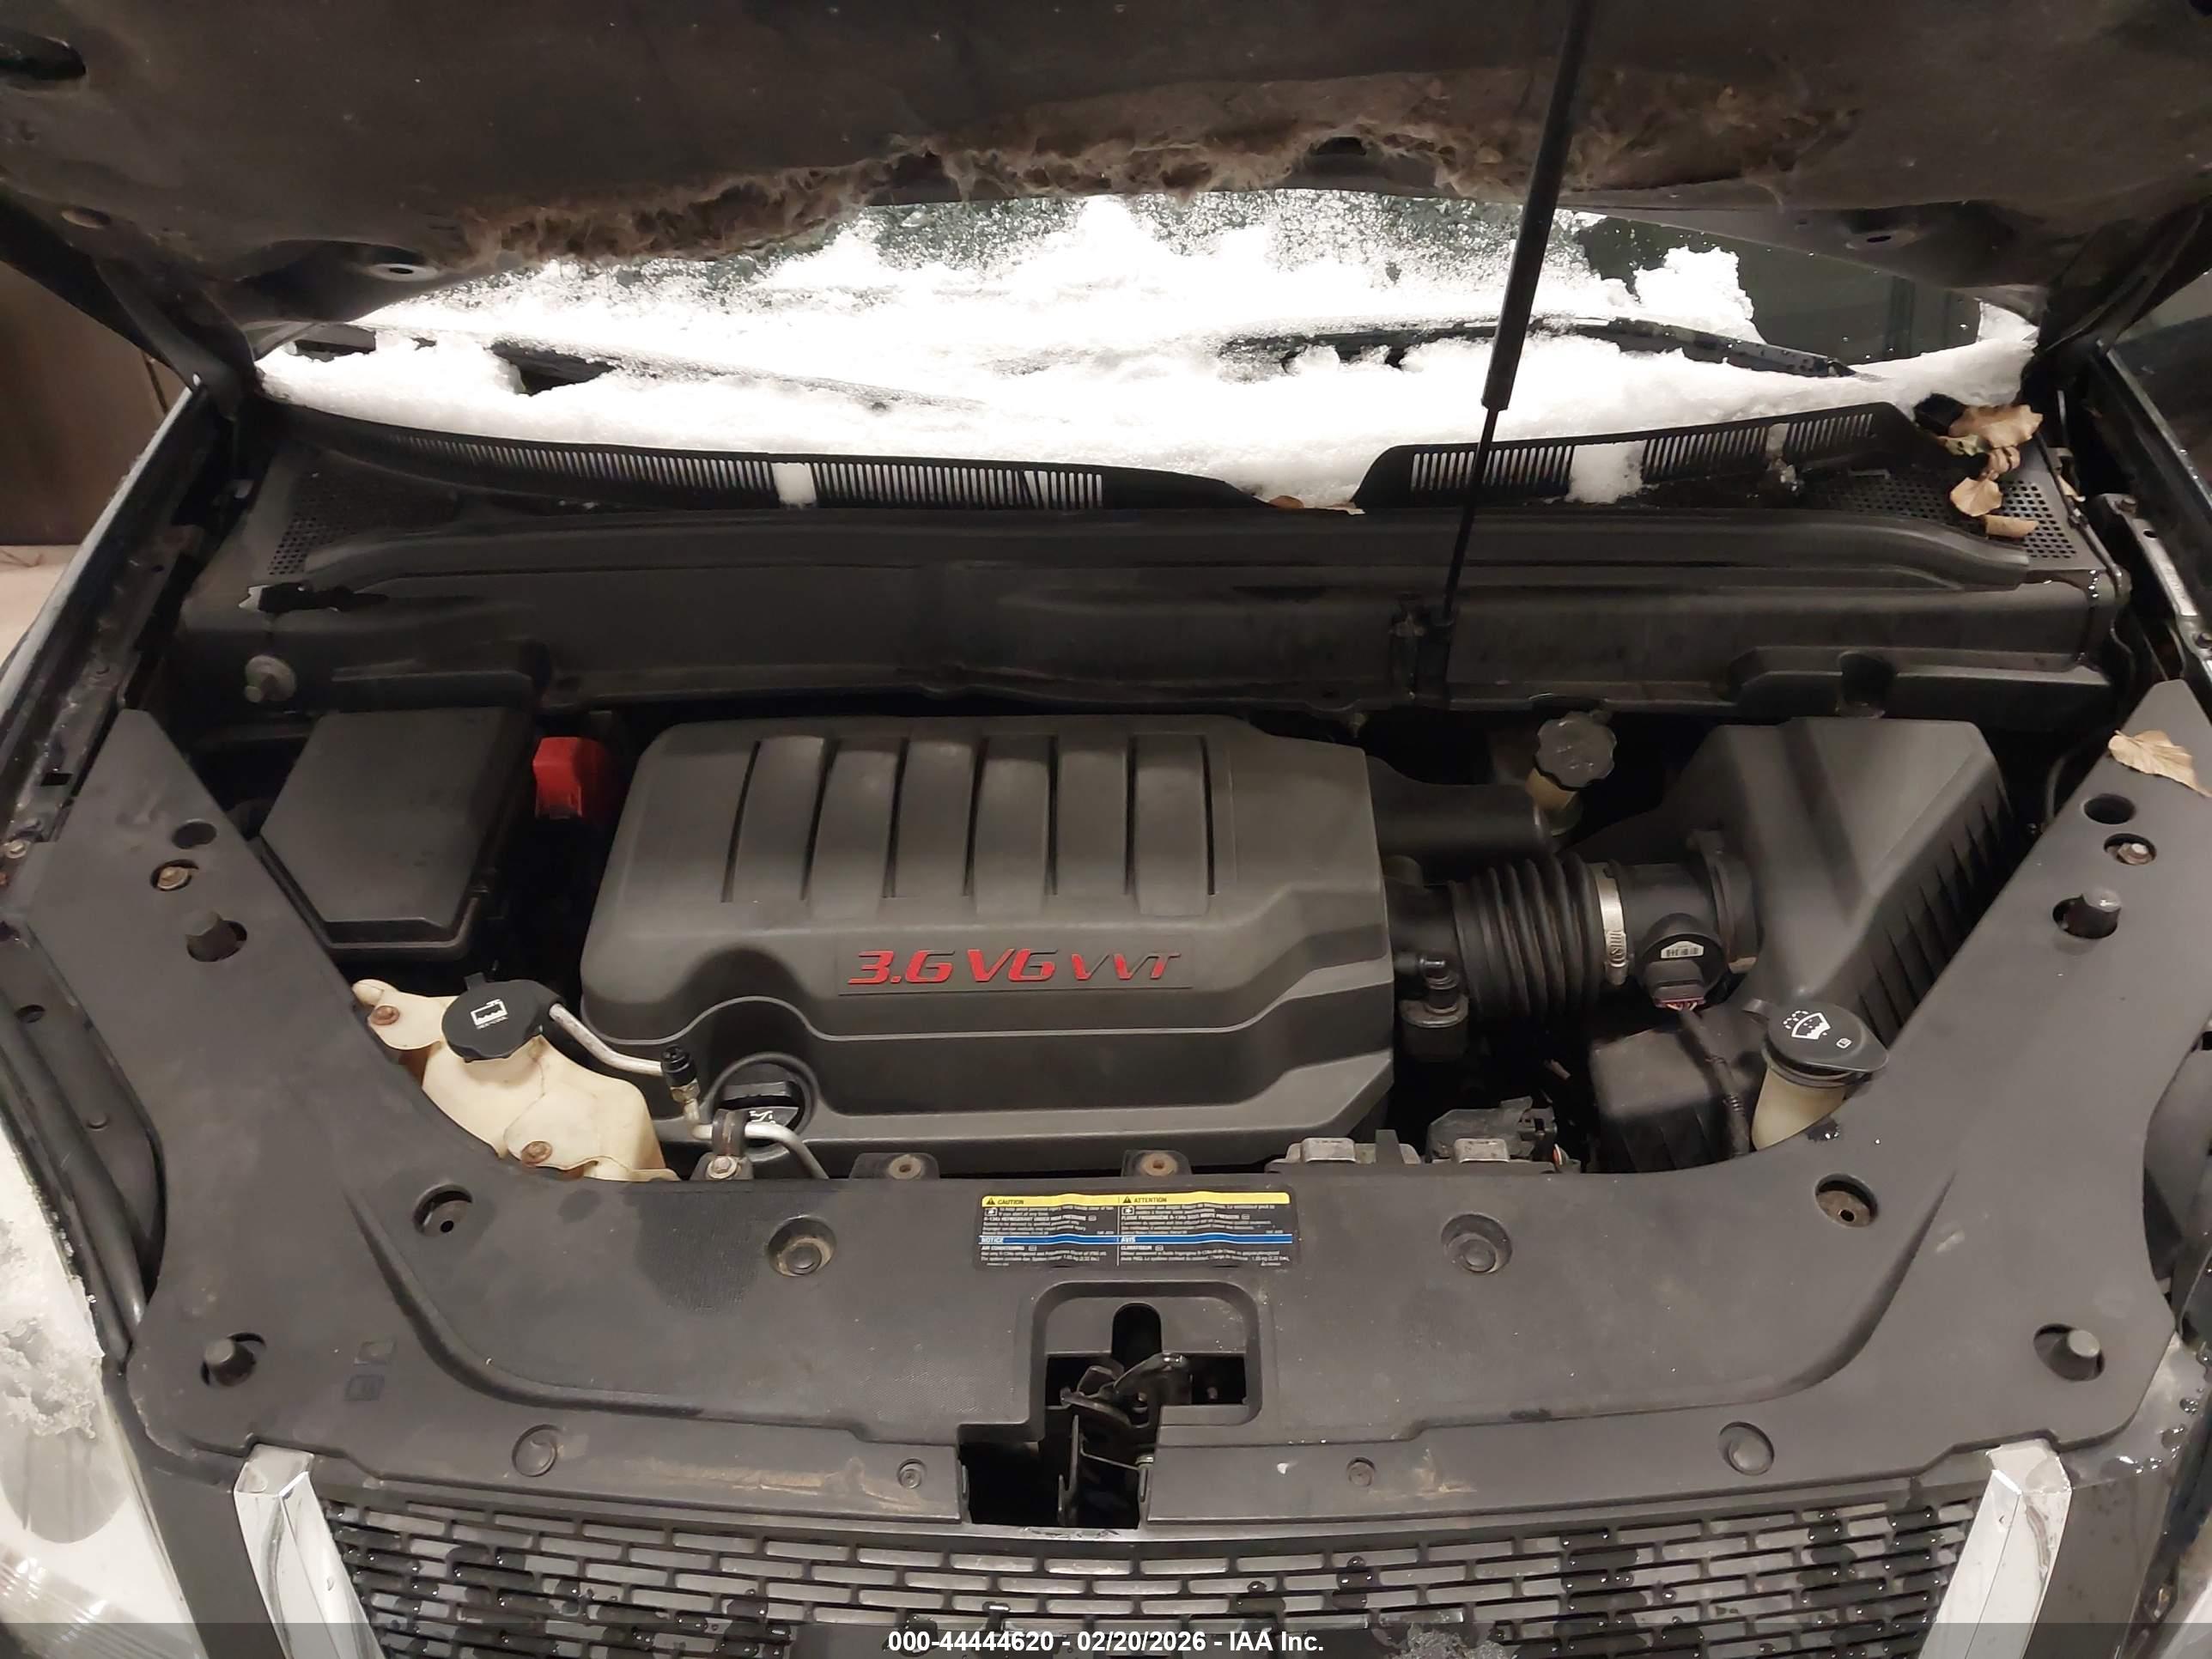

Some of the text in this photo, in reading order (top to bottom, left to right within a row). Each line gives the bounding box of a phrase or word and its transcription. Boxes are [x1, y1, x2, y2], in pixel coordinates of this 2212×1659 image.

[848, 947, 1182, 985] 3.6 V6 VVT
